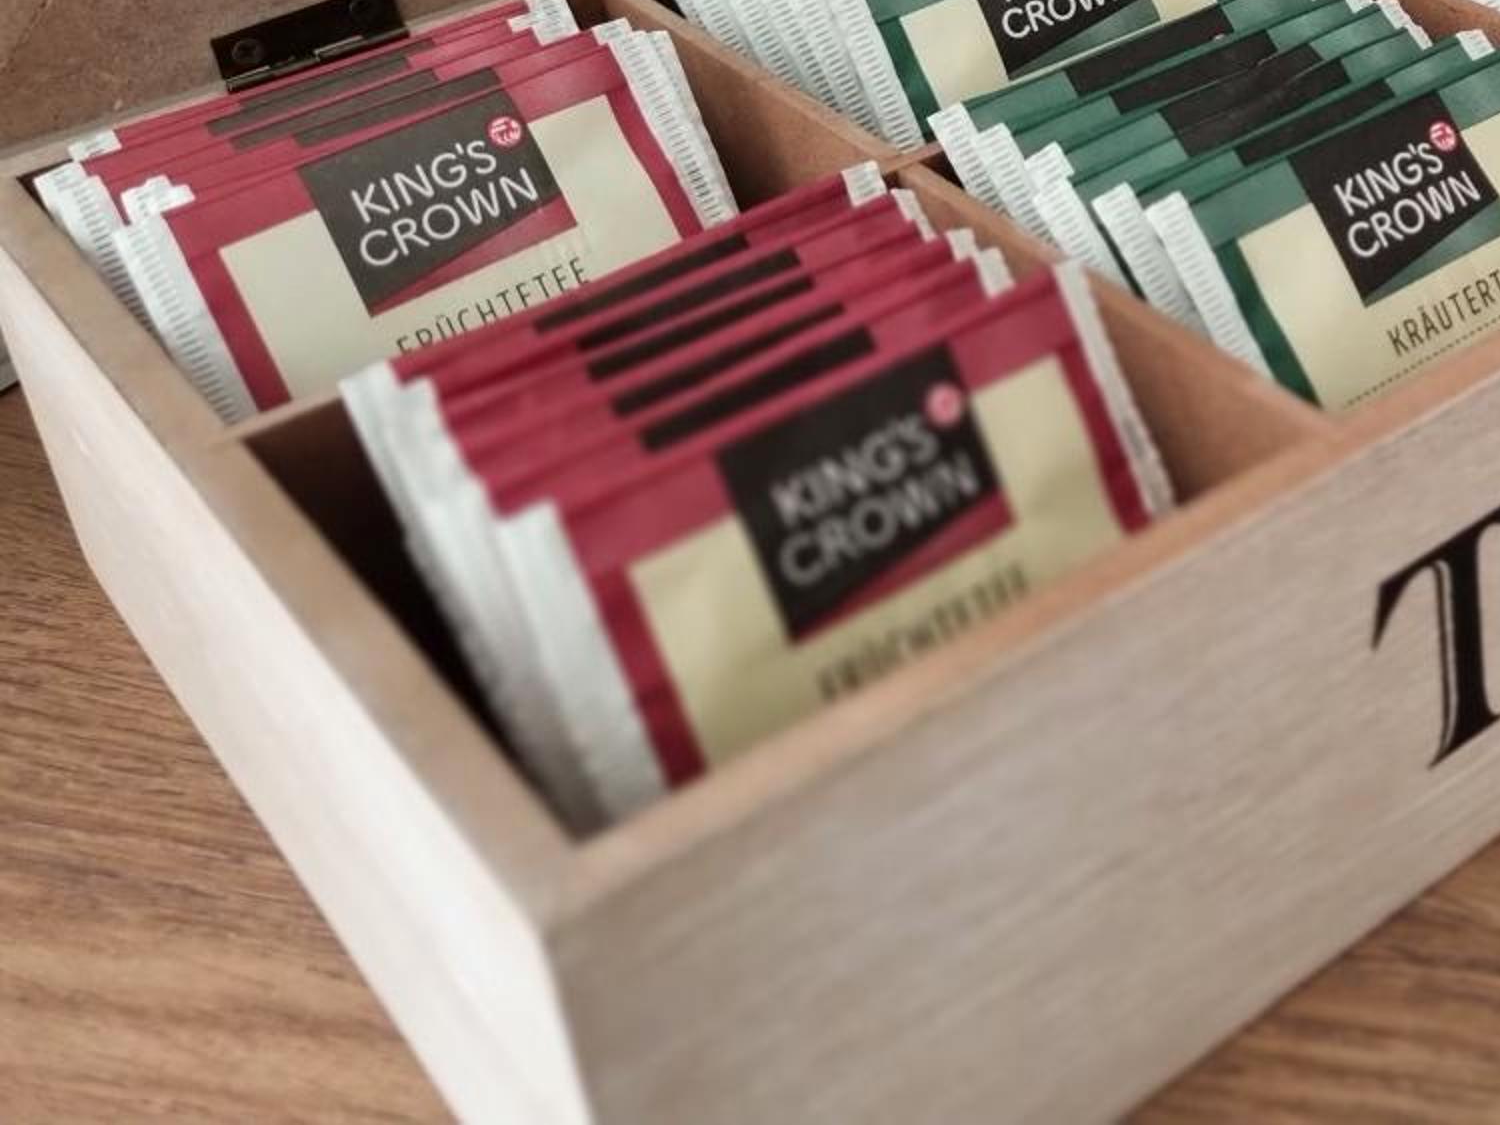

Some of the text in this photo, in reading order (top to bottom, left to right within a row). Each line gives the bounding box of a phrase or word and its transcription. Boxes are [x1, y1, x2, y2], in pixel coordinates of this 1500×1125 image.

[351, 140, 498, 224] KING'S
[359, 167, 539, 266] CROWN
[1333, 141, 1444, 217] KING'S
[1347, 170, 1481, 258] CROWN
[778, 449, 981, 586] CROWN
